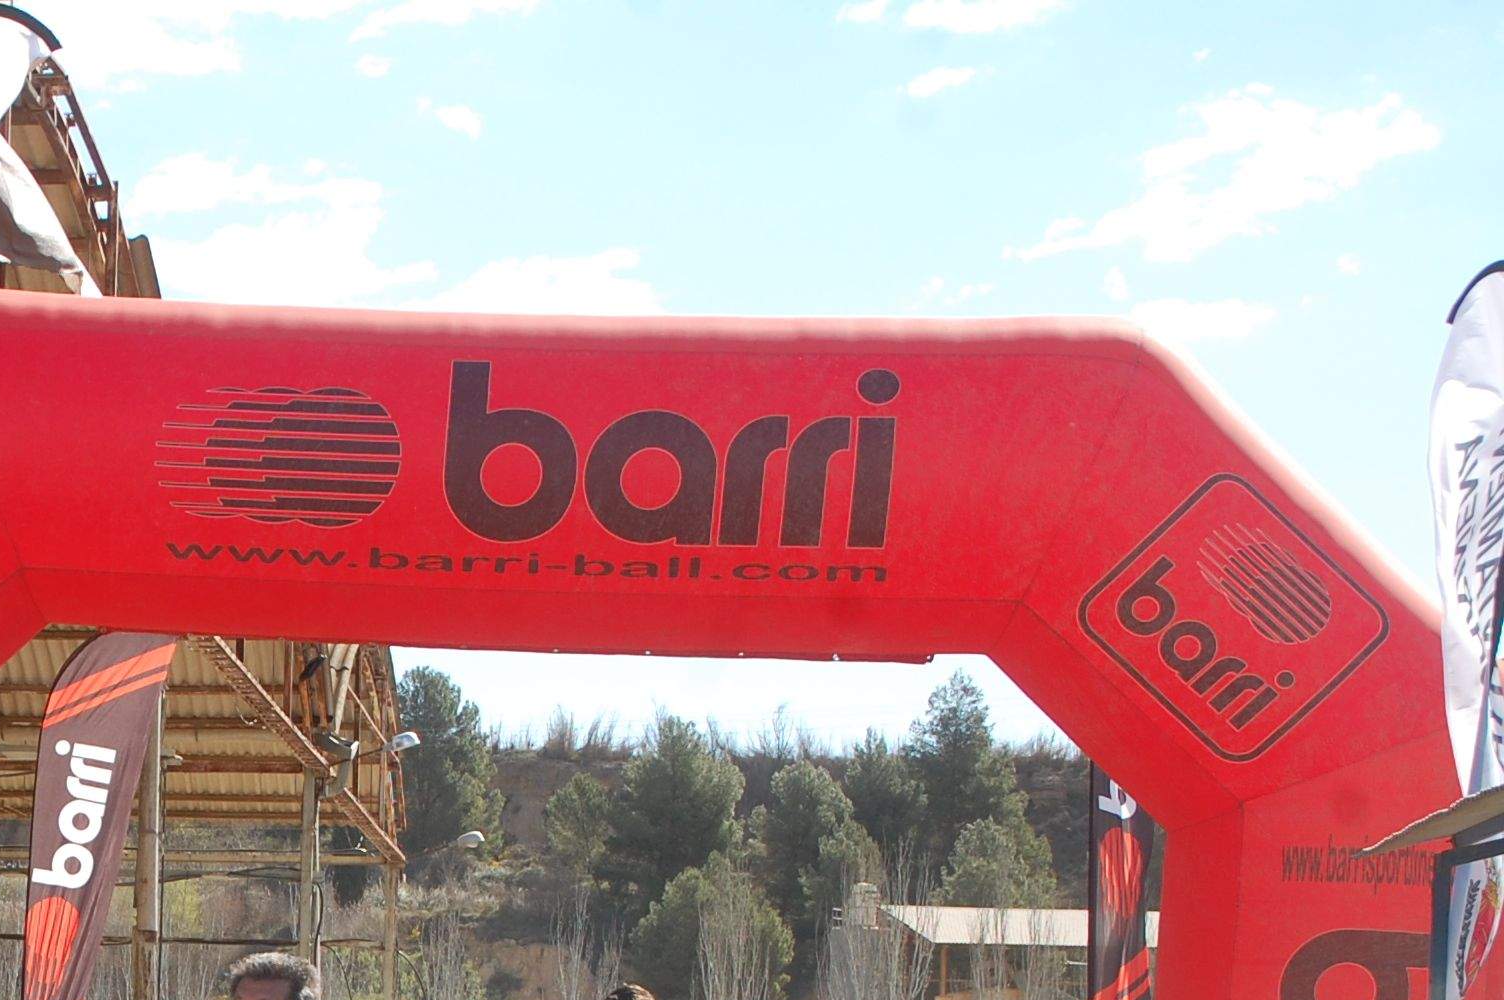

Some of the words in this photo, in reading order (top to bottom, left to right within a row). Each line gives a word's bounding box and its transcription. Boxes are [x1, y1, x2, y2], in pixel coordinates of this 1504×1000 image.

[442, 359, 901, 550] barri
[165, 541, 889, 583] www.barri-ball.com
[1115, 554, 1296, 732] barri
[31, 740, 117, 890] barri
